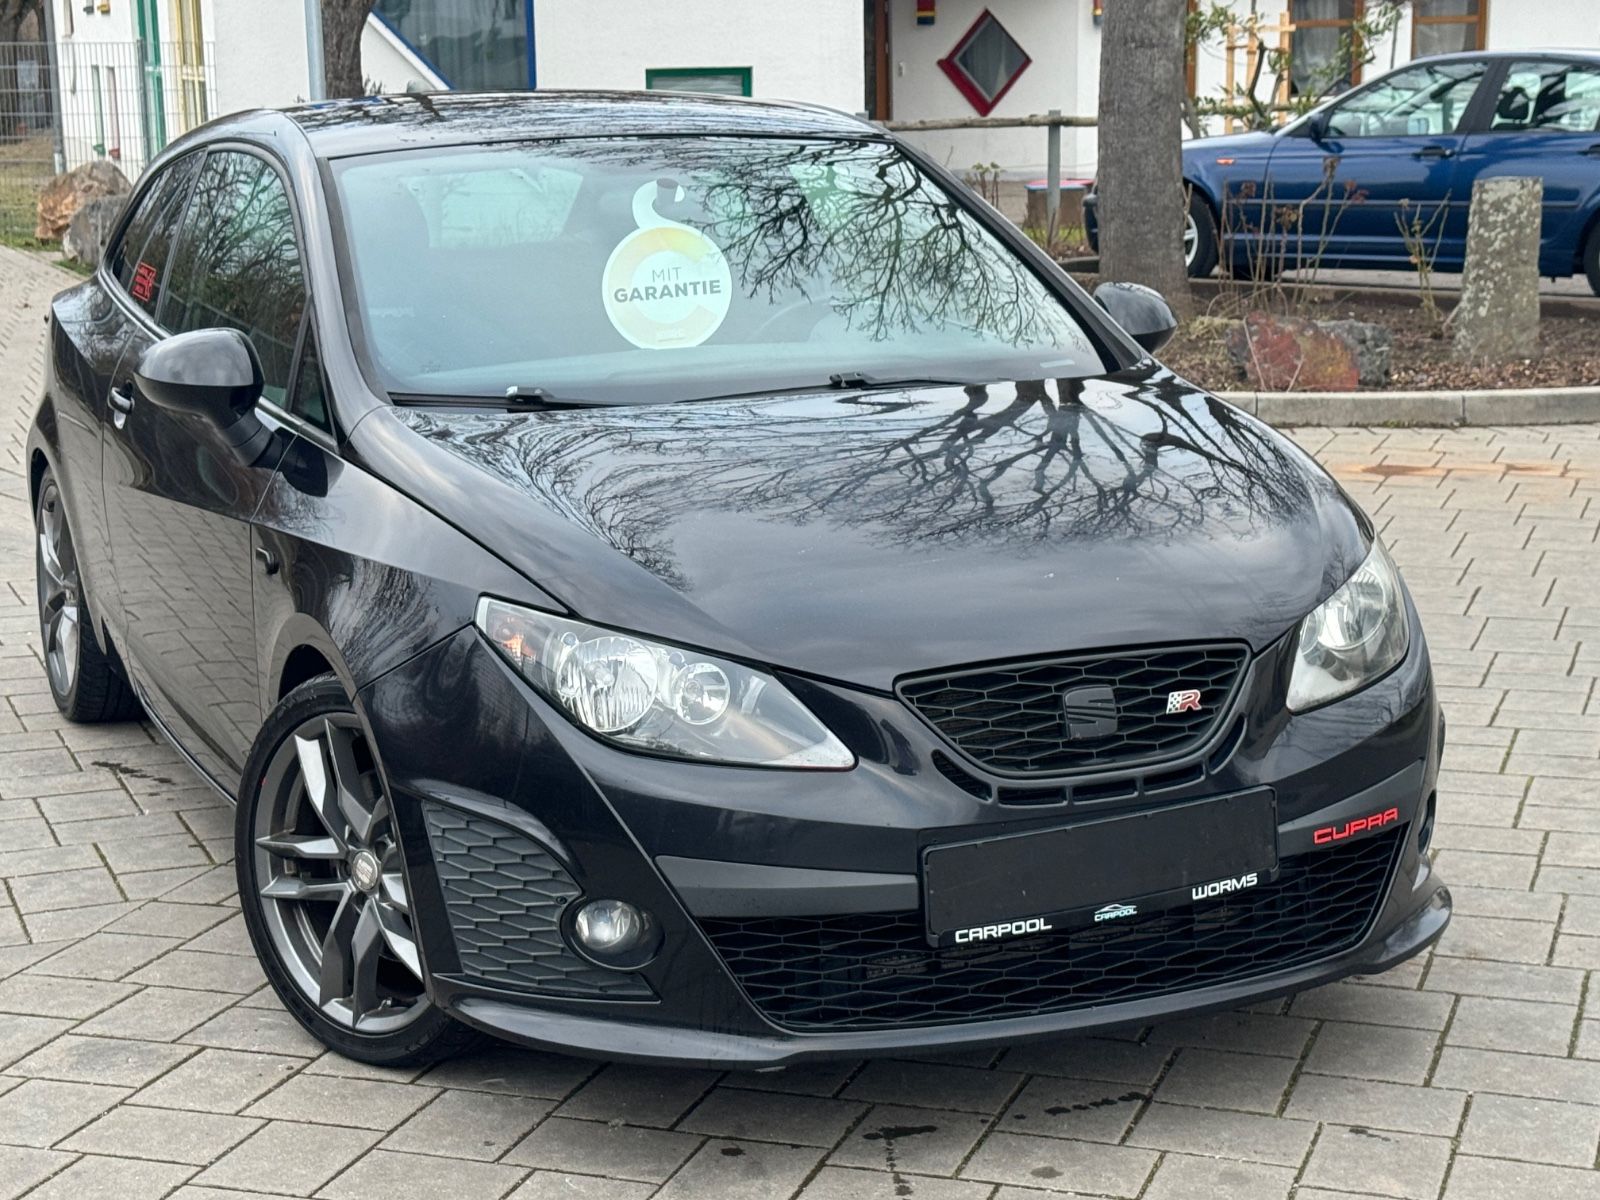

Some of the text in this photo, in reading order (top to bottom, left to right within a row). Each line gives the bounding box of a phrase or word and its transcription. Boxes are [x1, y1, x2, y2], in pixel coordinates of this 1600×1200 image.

[652, 266, 682, 283] MIT
[613, 279, 722, 303] GARANTIE
[1313, 807, 1399, 845] CUPRA
[1192, 872, 1258, 900] WORMS
[1094, 906, 1138, 922] CARPOOL
[954, 917, 1052, 943] CARPOOL
